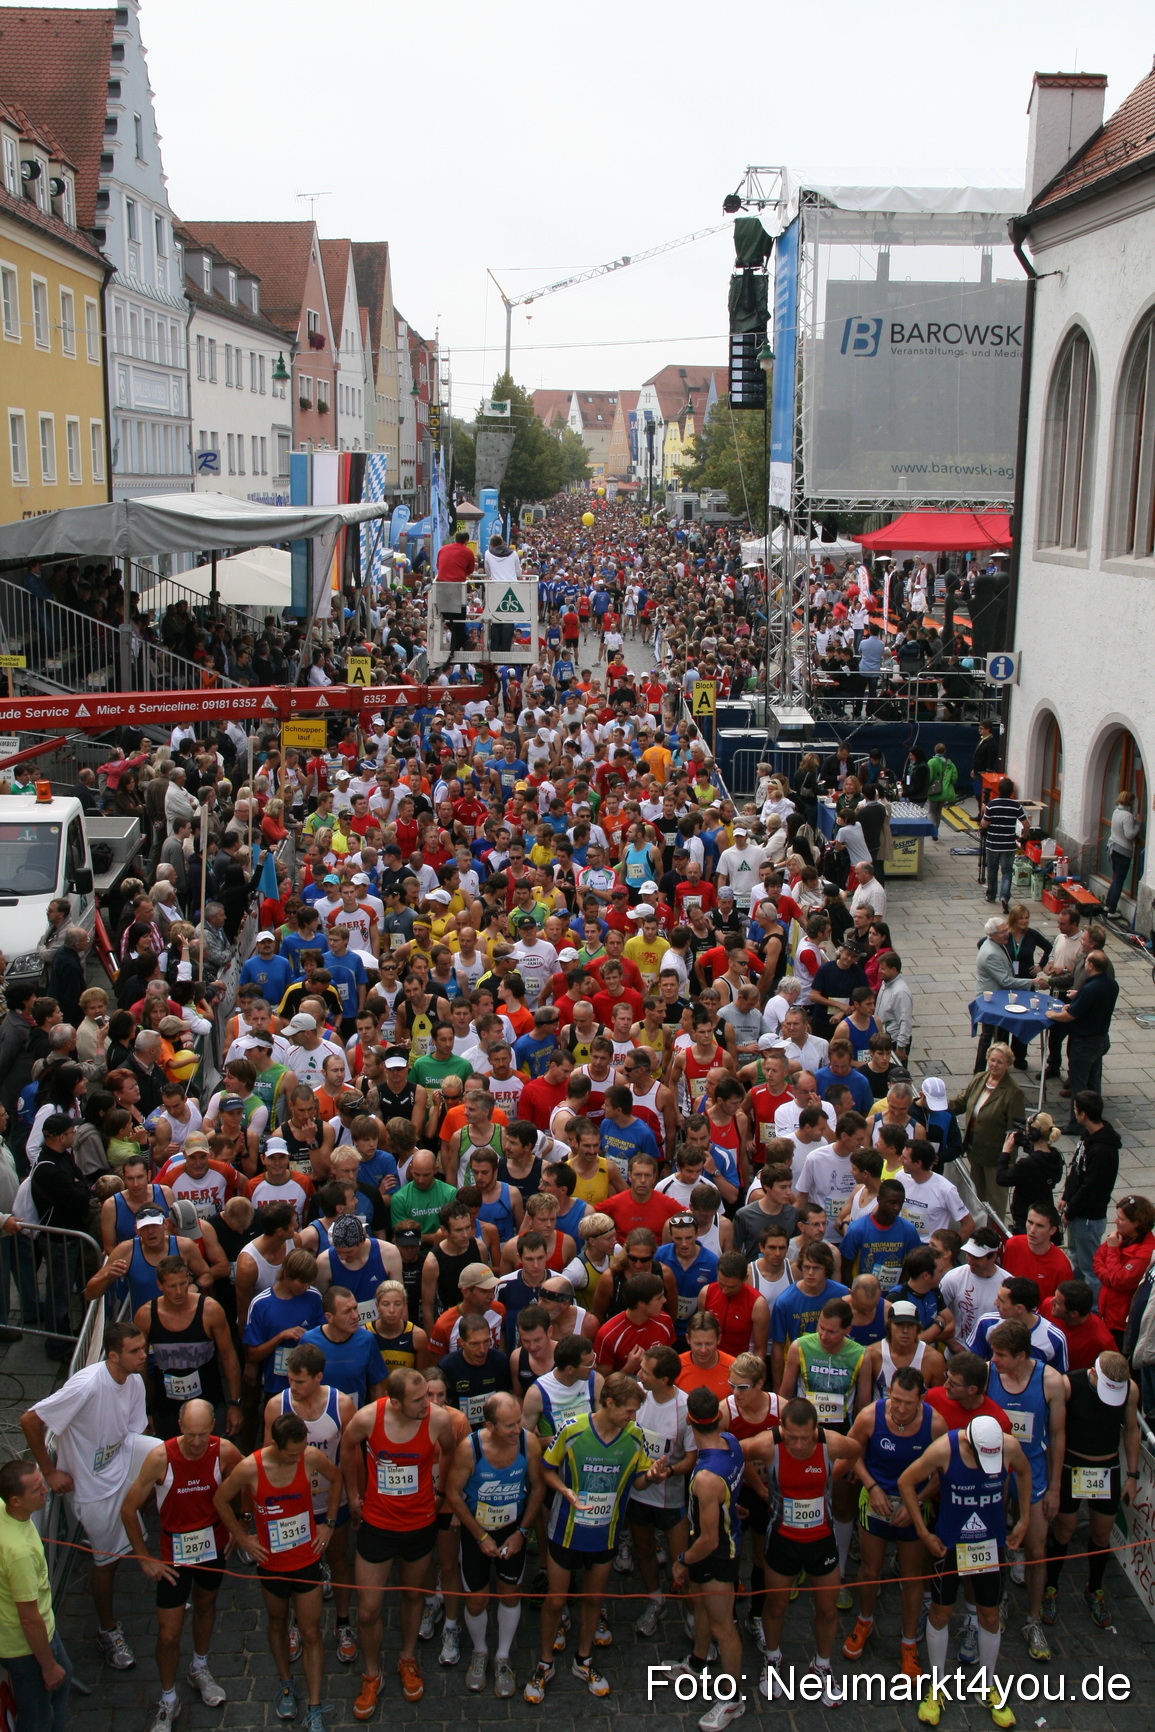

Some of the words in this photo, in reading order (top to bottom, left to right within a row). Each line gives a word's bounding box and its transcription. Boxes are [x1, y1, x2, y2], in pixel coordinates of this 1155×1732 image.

[890, 346, 968, 358] Veranstaltungs-
[972, 348, 991, 357] und
[891, 462, 1014, 480] www.barowski-ag
[353, 667, 366, 684] A
[363, 694, 387, 704] 6352
[698, 691, 711, 708] A
[97, 704, 125, 716] Miet-
[128, 704, 136, 714] &
[139, 702, 199, 713] Serviceline:
[201, 700, 230, 710] 09181
[232, 698, 257, 708] 6352
[25, 707, 70, 719] Service
[285, 725, 324, 735] Schnupper-
[177, 1187, 219, 1201] MERZ
[810, 1365, 849, 1376] BOCK
[174, 1381, 199, 1394] 2114
[818, 1403, 837, 1413] 609
[583, 1464, 621, 1473] BOCK
[388, 1474, 414, 1484] 3318
[1086, 1479, 1104, 1489] 348
[951, 1491, 1002, 1507] hapo
[587, 1504, 611, 1515] 2002
[795, 1509, 821, 1520] 2000
[279, 1519, 297, 1528] Marco
[491, 1514, 510, 1523] 119
[282, 1524, 307, 1540] 3315
[183, 1534, 199, 1542] Erwin
[185, 1539, 211, 1554] 2870
[971, 1551, 992, 1563] 903
